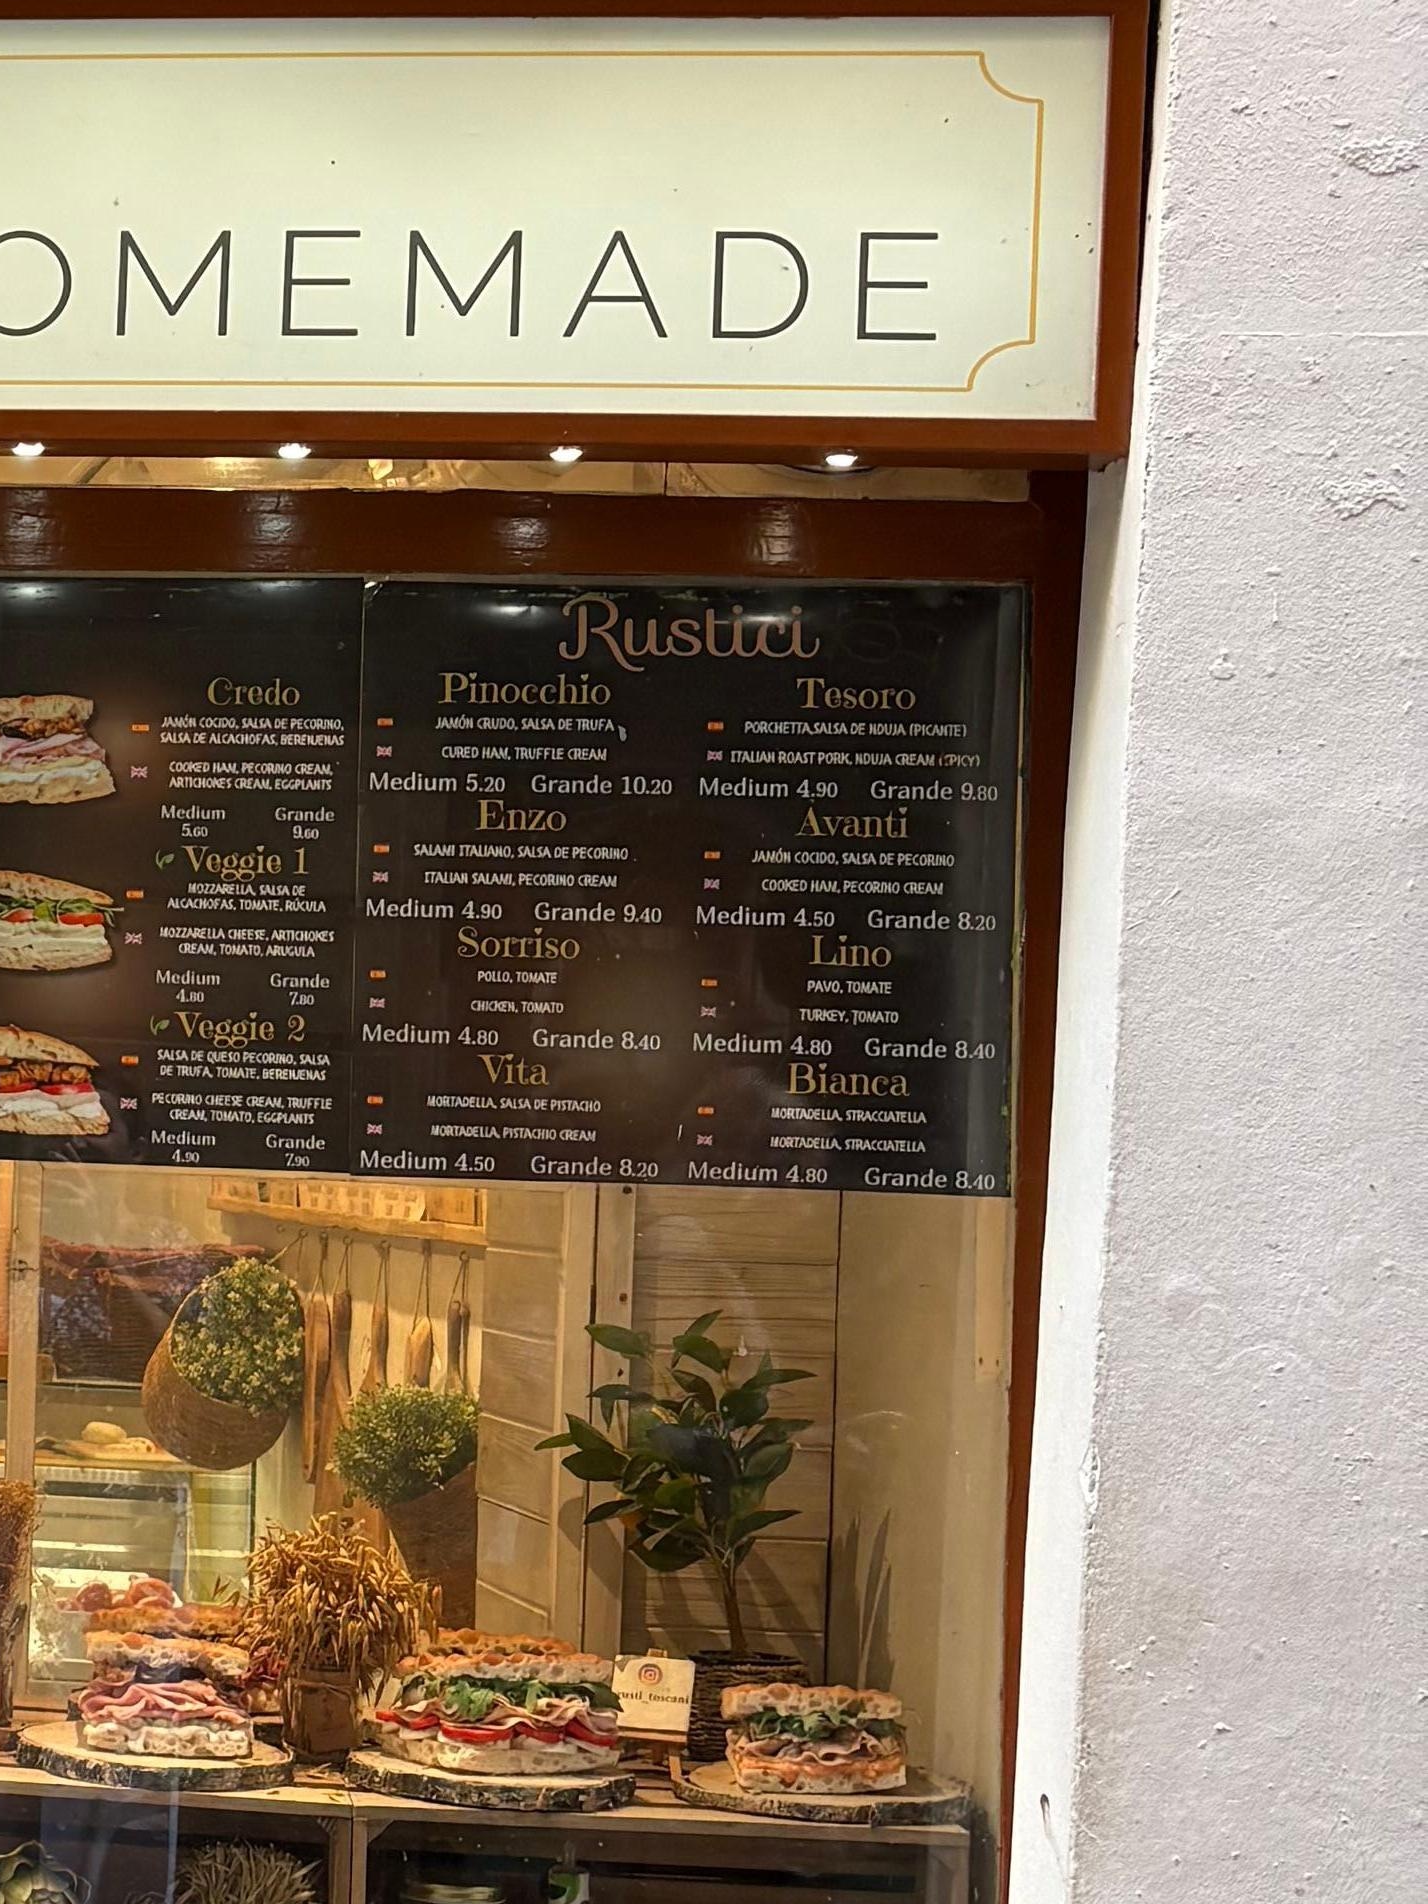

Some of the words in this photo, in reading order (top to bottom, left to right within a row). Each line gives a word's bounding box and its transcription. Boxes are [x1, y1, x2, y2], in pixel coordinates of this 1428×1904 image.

[558, 592, 820, 672] Rustici
[208, 677, 300, 706] Credo
[438, 672, 611, 705] Pinocchio
[796, 677, 916, 710] Tesoro
[436, 714, 473, 730] JAMÓN
[477, 717, 517, 731] CRUDO,
[521, 718, 555, 730] SALSA
[558, 719, 573, 731] DE
[576, 719, 614, 732] TRUFA
[442, 746, 479, 759] CURED
[514, 748, 565, 760] TRUFFLE
[568, 748, 607, 761] CREAM
[731, 751, 775, 763] ITALIAN
[778, 751, 815, 764] ROAST
[855, 752, 892, 765] NDUJA
[895, 753, 935, 766] CREAM
[169, 762, 209, 772] COOKED
[369, 772, 457, 793] Medium
[466, 774, 505, 793] 5.20
[531, 775, 612, 795] Grande
[622, 776, 672, 795] 10.20
[699, 777, 788, 797] Medium
[796, 779, 838, 798] 4.90
[871, 780, 953, 800] Grande
[961, 782, 998, 801] 9.80
[161, 805, 226, 820] Medium
[275, 807, 335, 821] Grande
[475, 800, 566, 831] Enzo
[795, 806, 909, 838] Avanti
[182, 845, 282, 881] Veggie
[294, 847, 308, 874] 1
[518, 845, 551, 858] SALSA
[554, 846, 569, 859] DE
[572, 847, 628, 860] PECORINO
[424, 871, 468, 885] ITALIAN
[519, 873, 574, 886] PECORINO
[578, 874, 617, 887] CREAM
[366, 898, 453, 918] Medium
[462, 900, 502, 919] 4.90
[534, 901, 616, 922] Grande
[623, 903, 662, 923] 9.40
[697, 905, 785, 926] Medium
[794, 907, 834, 926] 4.50
[868, 909, 950, 929] Grande
[958, 911, 996, 930] 8.20
[457, 926, 580, 959] Sorriso
[809, 935, 892, 967] Lino
[156, 970, 220, 985] Medium
[270, 973, 330, 988] Grande
[477, 971, 513, 983] POLLO,
[516, 971, 557, 983] TOMATE
[807, 980, 843, 993] PAVO,
[846, 981, 892, 993] TOMATE
[471, 1000, 518, 1013] CHICKEN,
[521, 1001, 563, 1013] TOMATO
[799, 1008, 849, 1022] TURKEY,
[852, 1010, 899, 1024] TOMATO
[174, 1011, 274, 1047] Veggie
[288, 1015, 305, 1042] 2
[362, 1023, 450, 1044] Medium
[458, 1025, 498, 1045] 4.80
[533, 1028, 614, 1049] Grande
[621, 1031, 661, 1051] 8.40
[693, 1032, 782, 1053] Medium
[790, 1035, 832, 1055] 4.80
[864, 1037, 947, 1057] Grande
[955, 1040, 995, 1059] 8.40
[478, 1053, 549, 1085] Vita
[786, 1062, 910, 1096] Bianca
[500, 1097, 530, 1110] SALSA
[534, 1099, 547, 1111] DE
[550, 1099, 601, 1112] PISTACHO
[846, 1109, 926, 1123] STRACCIATELLA
[151, 1130, 216, 1145] Medium
[265, 1134, 325, 1150] Grande
[503, 1126, 557, 1139] PISTACHIO
[559, 1129, 596, 1141] CREAM
[360, 1150, 447, 1170] Medium
[454, 1152, 494, 1172] 4.50
[531, 1155, 611, 1176] Grande
[620, 1158, 658, 1177] 8.20
[688, 1162, 778, 1182] Medium
[786, 1163, 827, 1183] 4.80
[864, 1167, 947, 1187] Grande
[955, 1170, 994, 1189] 8.40
